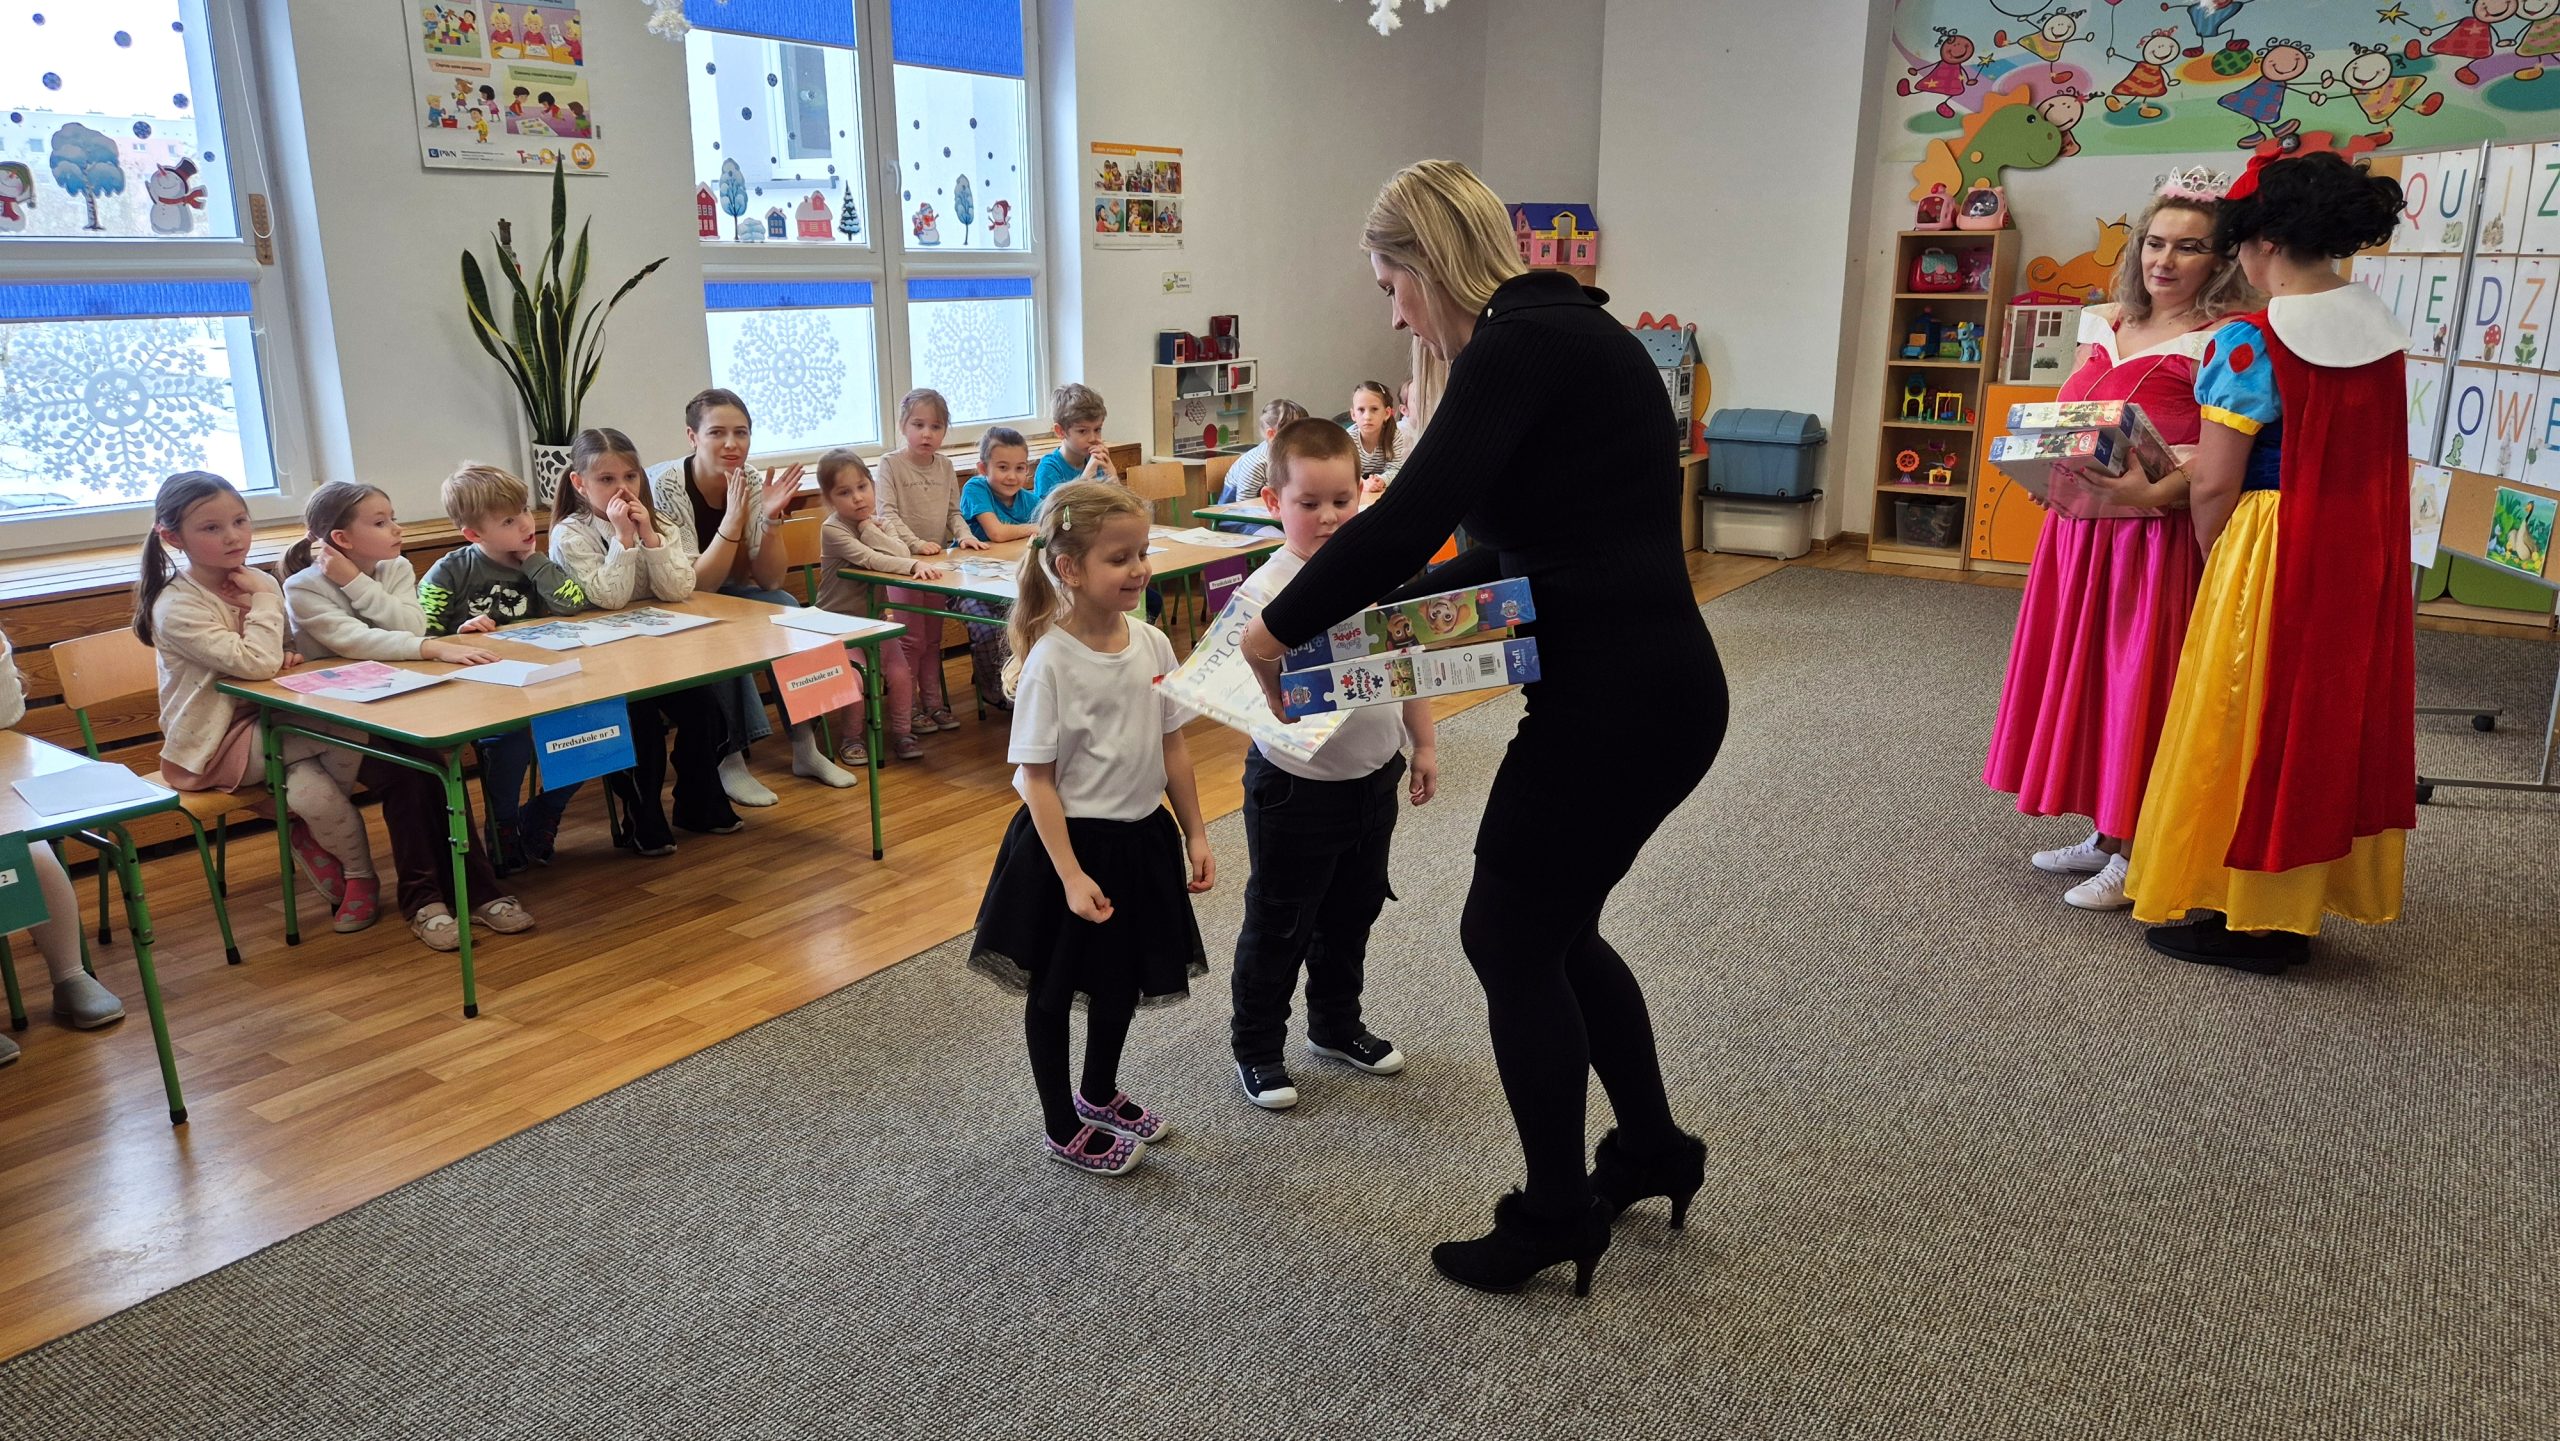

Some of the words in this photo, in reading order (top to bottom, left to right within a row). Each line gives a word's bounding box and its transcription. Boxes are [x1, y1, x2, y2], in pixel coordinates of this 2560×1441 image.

[440, 150, 457, 158] PWN
[2404, 163, 2560, 230] QUIZ
[1332, 628, 1361, 641] SHAPE
[1511, 649, 1521, 668] Trefl
[791, 672, 826, 689] Przedszkole
[1355, 667, 1371, 702] Amazing
[1363, 671, 1373, 696] shapes
[552, 733, 598, 750] Przedszkole
[599, 731, 608, 739] nr
[610, 728, 615, 737] 3
[0, 874, 8, 884] 2
